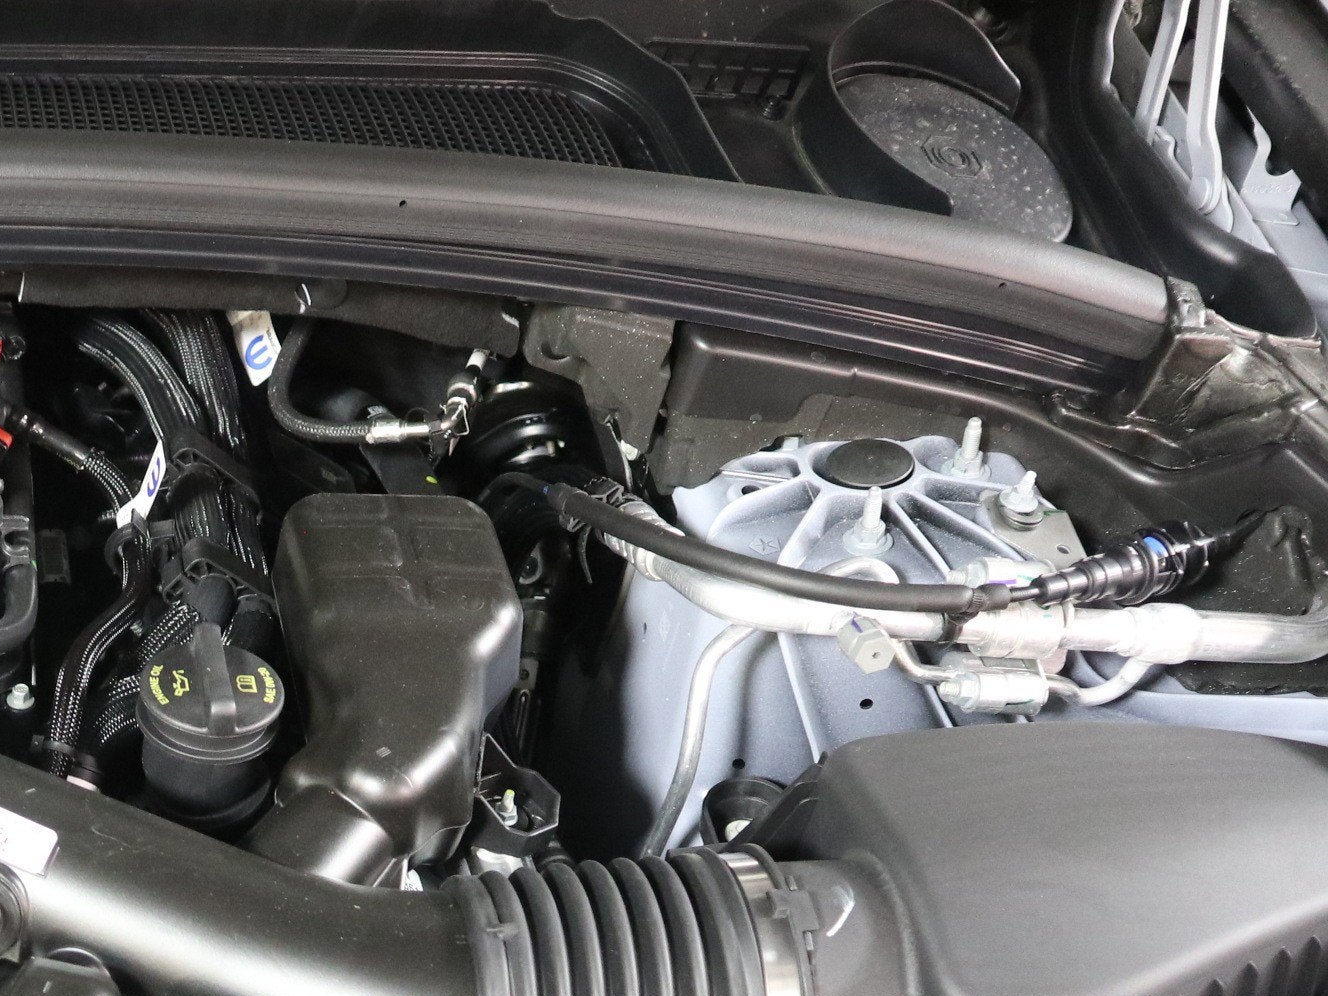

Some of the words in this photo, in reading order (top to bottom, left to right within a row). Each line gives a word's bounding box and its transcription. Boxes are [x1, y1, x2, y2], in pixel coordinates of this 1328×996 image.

[150, 664, 164, 676] OIL
[149, 676, 170, 705] ENGINE
[263, 687, 276, 704] SAE
